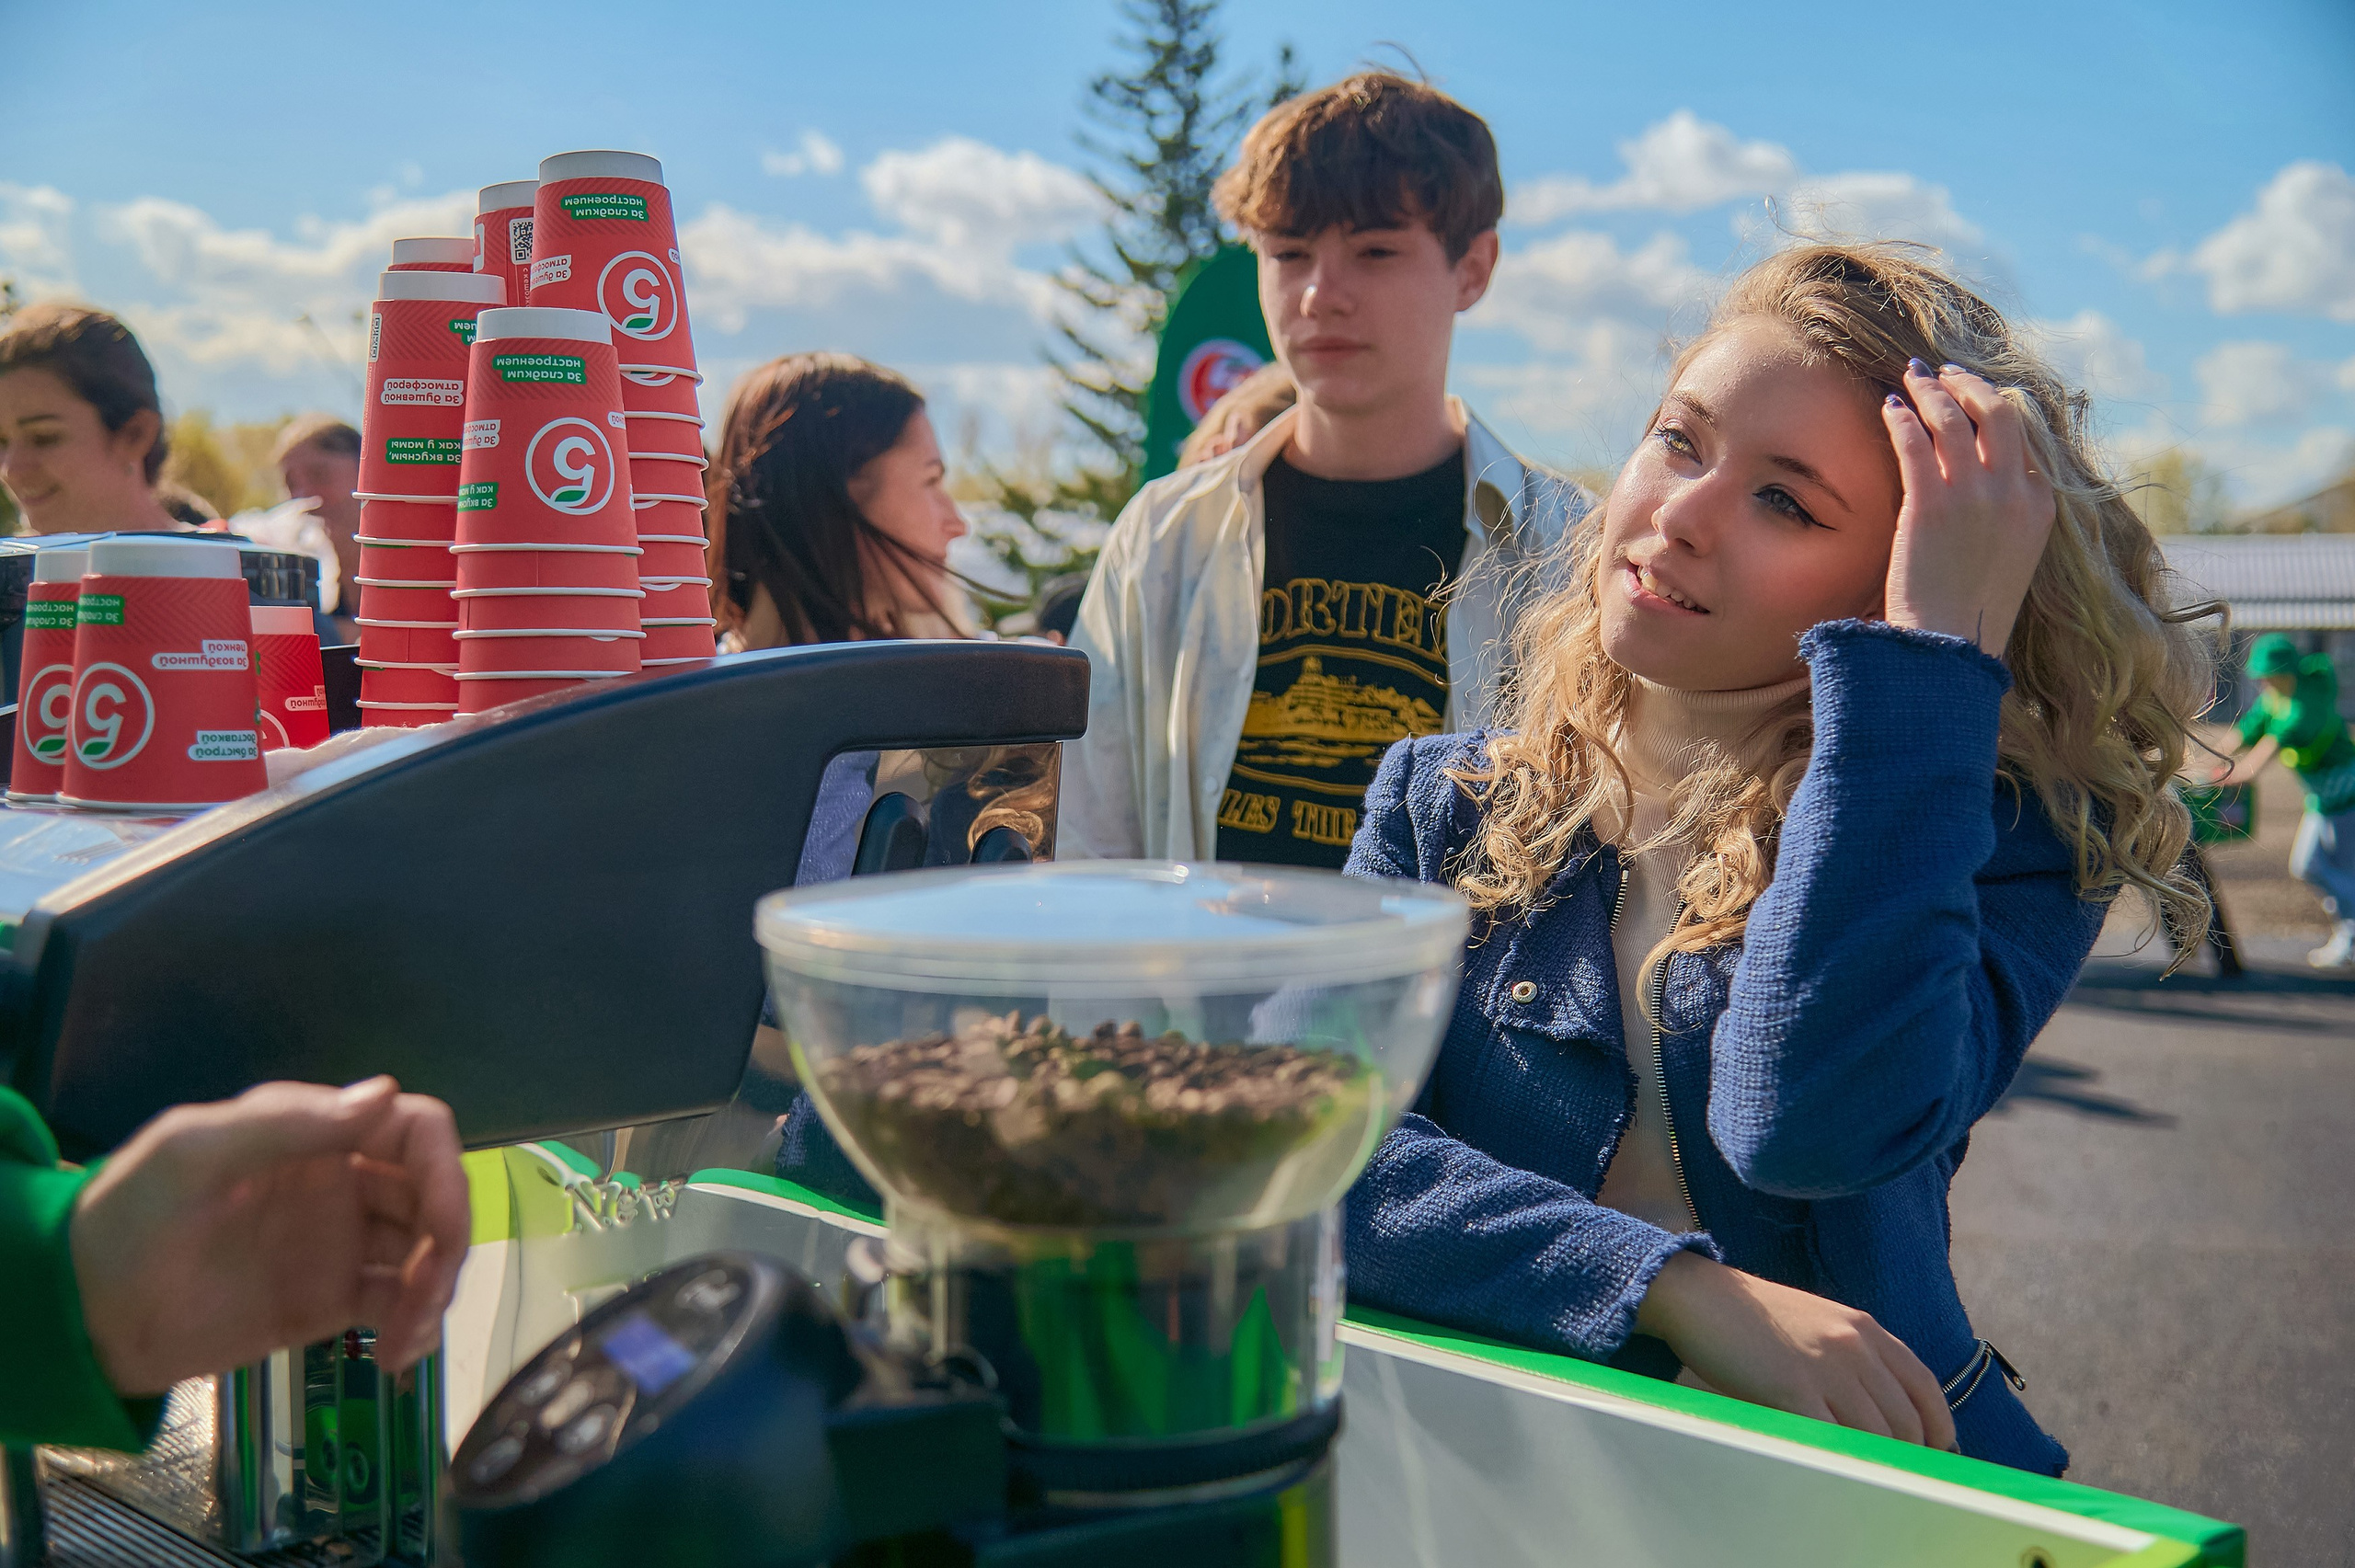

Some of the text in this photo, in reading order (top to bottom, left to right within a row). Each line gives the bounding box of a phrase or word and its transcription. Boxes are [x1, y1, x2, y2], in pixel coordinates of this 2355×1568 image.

[565, 195, 643, 207] настроением
[576, 208, 645, 219] За сладким
[556, 269, 568, 279] За
[497, 356, 581, 369] настроением
[507, 370, 581, 382] За сладким
[386, 380, 459, 392] атмосферой
[385, 392, 460, 404] За душевной
[391, 440, 461, 450] как у мамы
[485, 436, 497, 445] За
[388, 452, 462, 464] За вкусным,
[475, 485, 494, 495] как
[481, 498, 494, 508] За
[59, 617, 75, 627] За
[105, 612, 120, 623] За
[208, 643, 246, 653] пенкой
[159, 655, 248, 668] За воздушной
[201, 733, 257, 744] доставкой
[195, 746, 247, 758] быстрой
